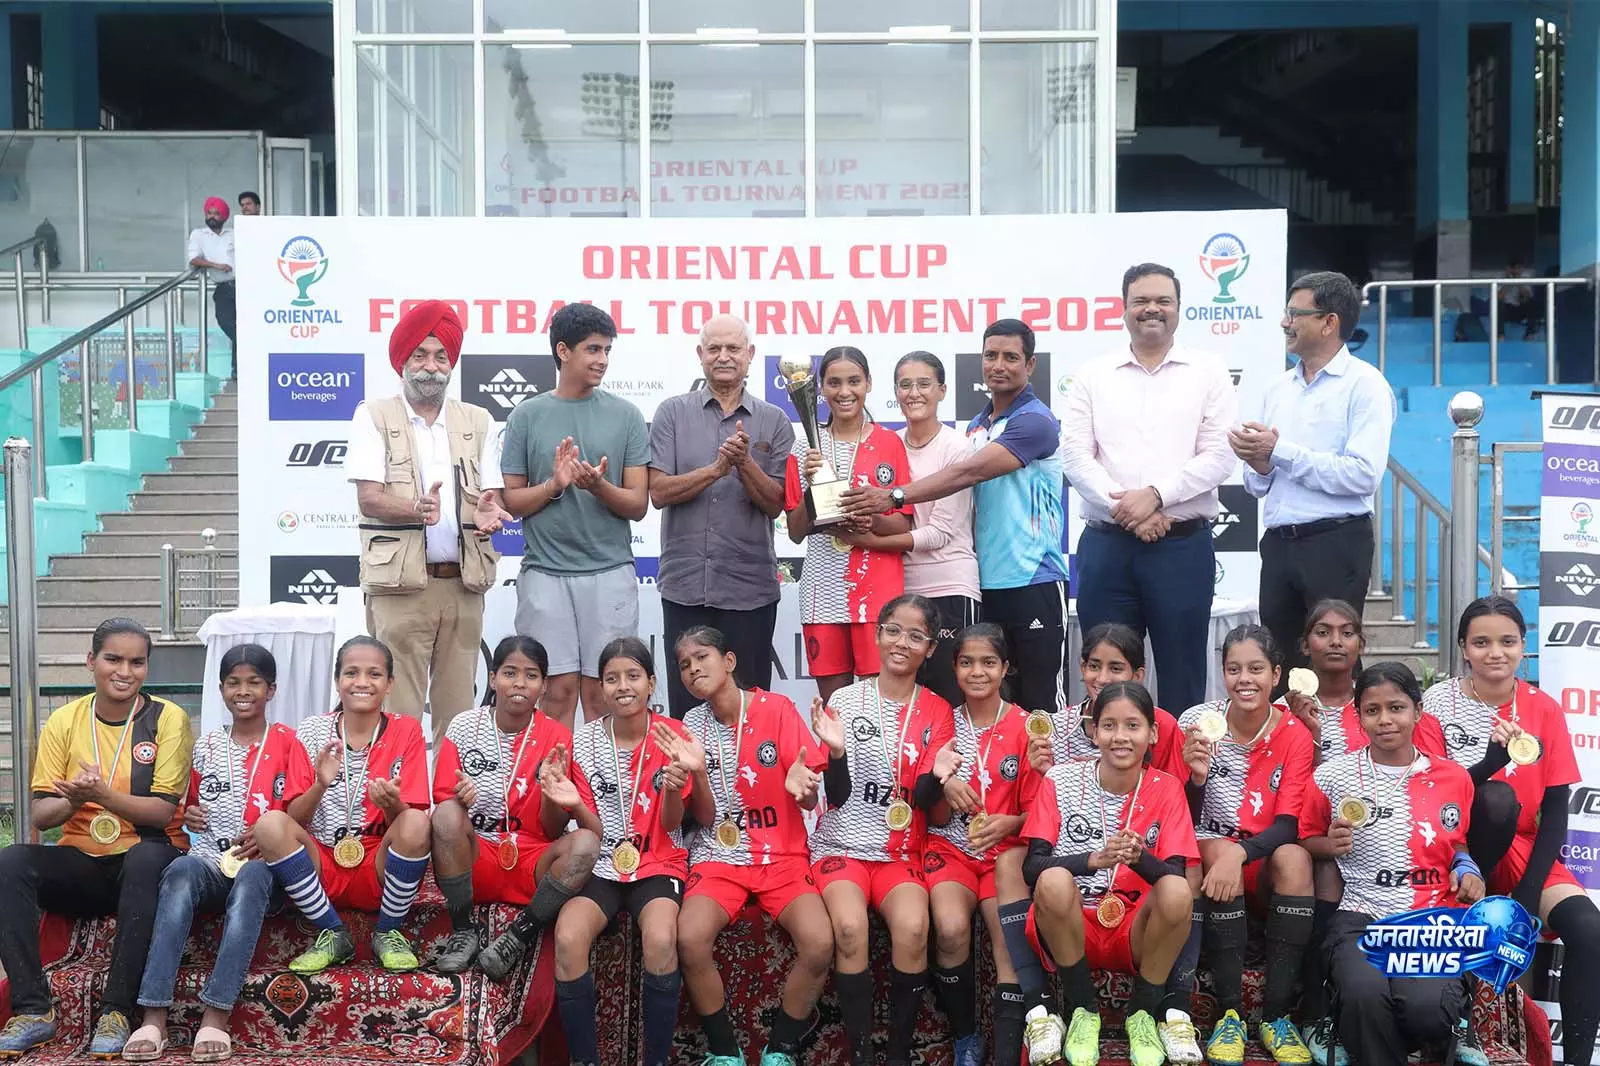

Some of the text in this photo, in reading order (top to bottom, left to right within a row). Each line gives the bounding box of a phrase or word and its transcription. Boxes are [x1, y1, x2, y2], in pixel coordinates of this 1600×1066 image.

[520, 186, 675, 204] FOOTBAL
[582, 244, 947, 280] ORIENTAL CUP
[264, 309, 343, 324] ORIENTAL
[368, 298, 636, 334] FTBL
[1021, 296, 1125, 332] 202
[1185, 305, 1263, 321] ORIENTAL
[290, 325, 320, 338] CUP
[1211, 322, 1240, 335] CUP
[479, 383, 538, 393] NIVIA
[602, 380, 664, 391] NTRAL PARK
[291, 391, 337, 403] beverages
[303, 512, 348, 524] CENTRAL
